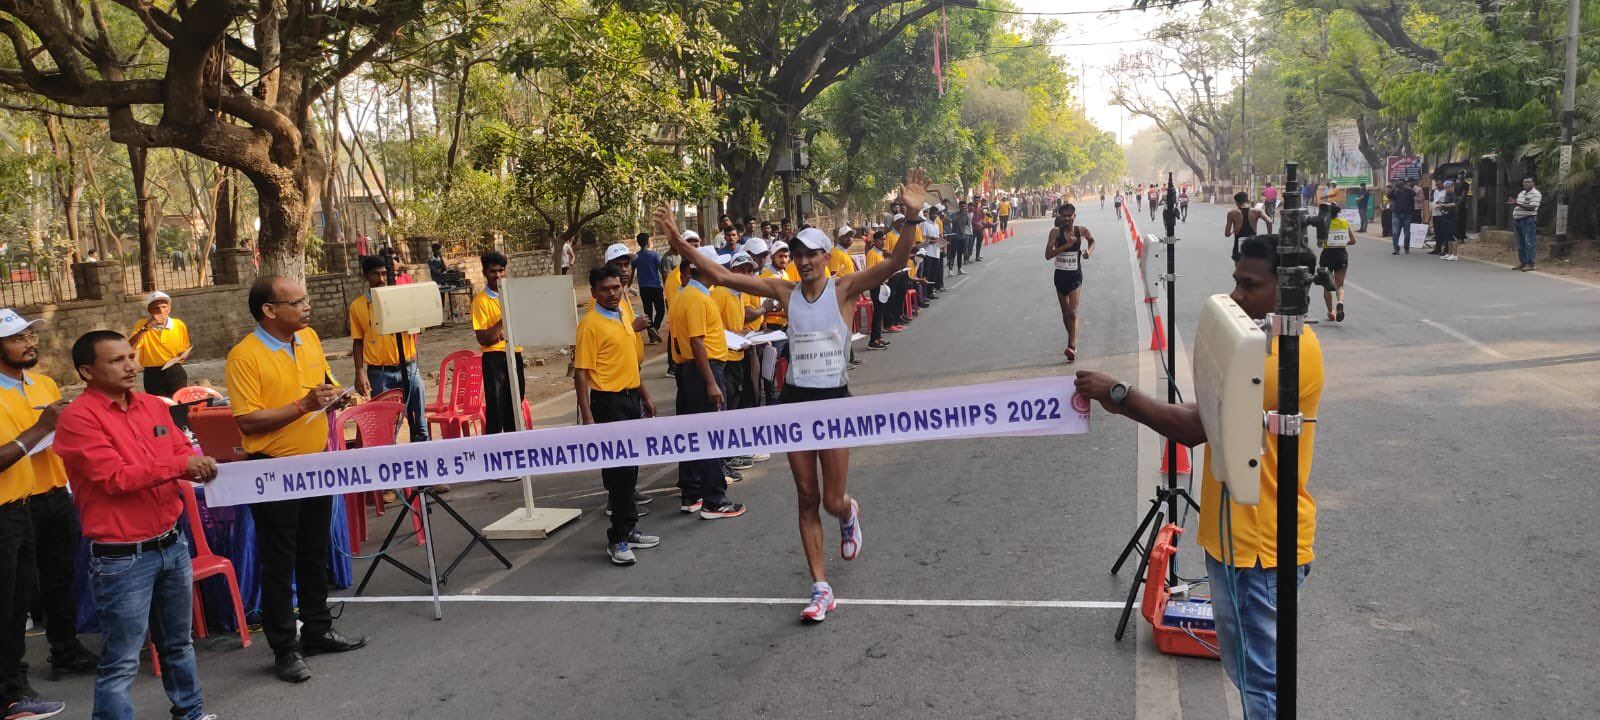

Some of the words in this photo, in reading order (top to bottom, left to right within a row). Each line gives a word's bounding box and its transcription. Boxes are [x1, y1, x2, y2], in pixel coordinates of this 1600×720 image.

[255, 471, 276, 495] 9TH
[282, 466, 372, 493] NATIONAL
[378, 460, 429, 483] OPEN
[436, 460, 449, 477] &
[453, 451, 476, 475] 5TH
[483, 439, 640, 473] INTERNATIONAL
[645, 432, 701, 457] RACE
[707, 422, 803, 451] WALKING
[812, 403, 998, 441] CHAMPIONSHIPS
[1007, 397, 1062, 423] 2022
